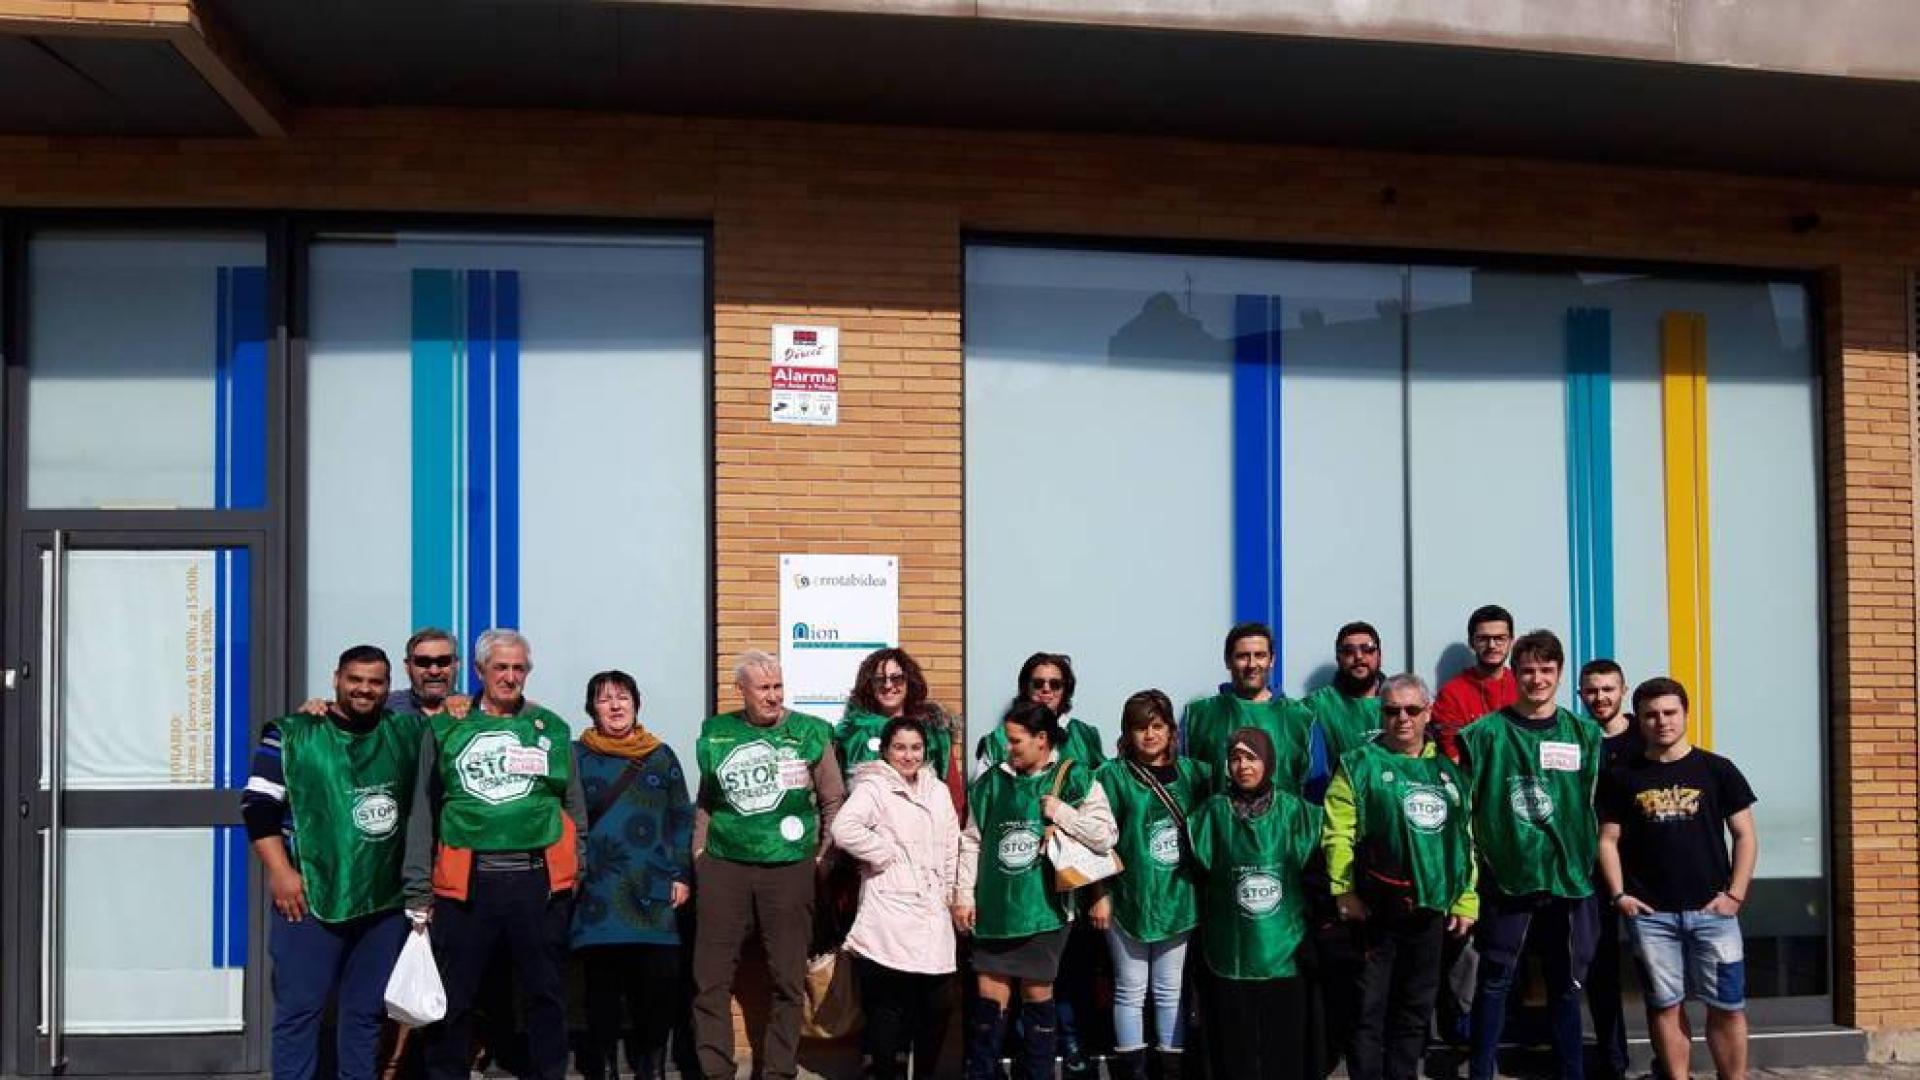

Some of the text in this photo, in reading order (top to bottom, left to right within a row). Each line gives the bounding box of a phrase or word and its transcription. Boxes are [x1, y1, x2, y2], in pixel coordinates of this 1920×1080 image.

[775, 367, 836, 383] Alarma
[358, 804, 395, 821] STOP
[1409, 801, 1444, 814] STOP
[1003, 841, 1037, 854] STOP
[1241, 885, 1279, 899] STOP
